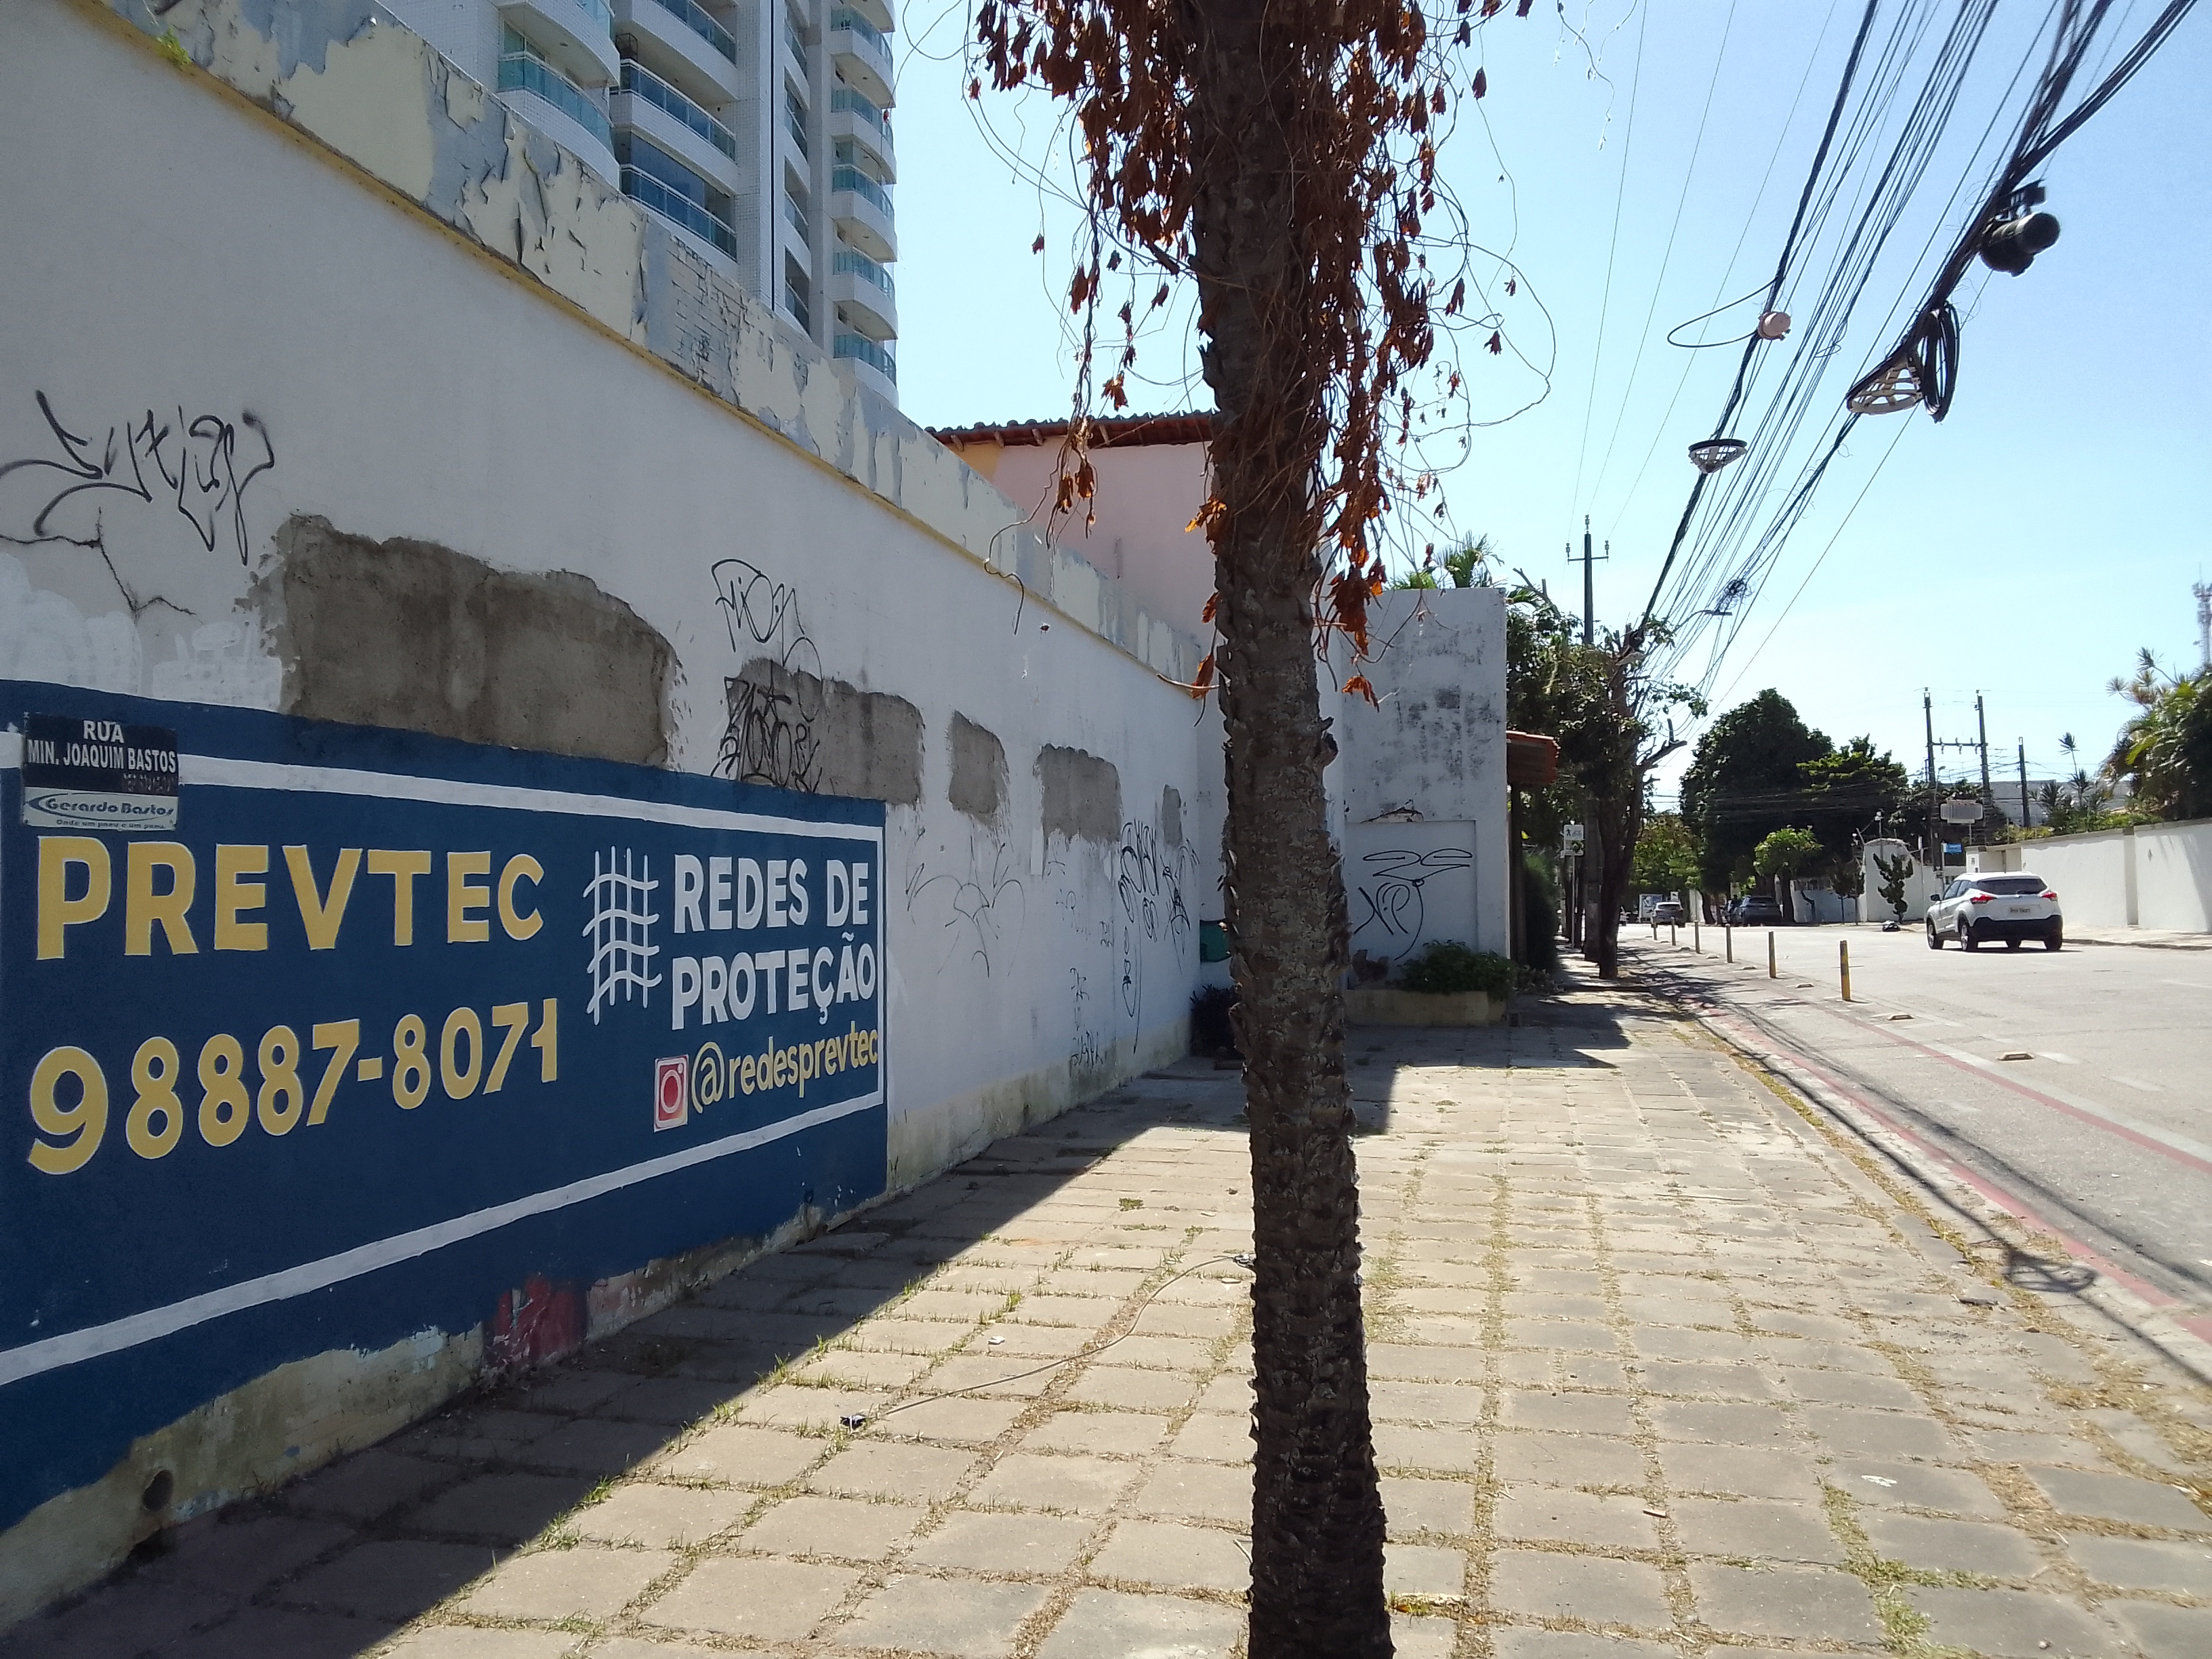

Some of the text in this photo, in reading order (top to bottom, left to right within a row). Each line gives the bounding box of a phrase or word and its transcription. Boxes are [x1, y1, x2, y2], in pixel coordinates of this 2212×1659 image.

[27, 739, 176, 773] MIN. JOAQUIM BASTOS
[83, 720, 125, 743] RUA
[45, 798, 174, 816] Gerardo Bastos
[37, 835, 544, 960] PREVTEC
[674, 854, 809, 933] REDES
[826, 859, 869, 927] DE
[672, 931, 876, 1030] PROTEÇÃO
[692, 1020, 878, 1113] @redesprevtec
